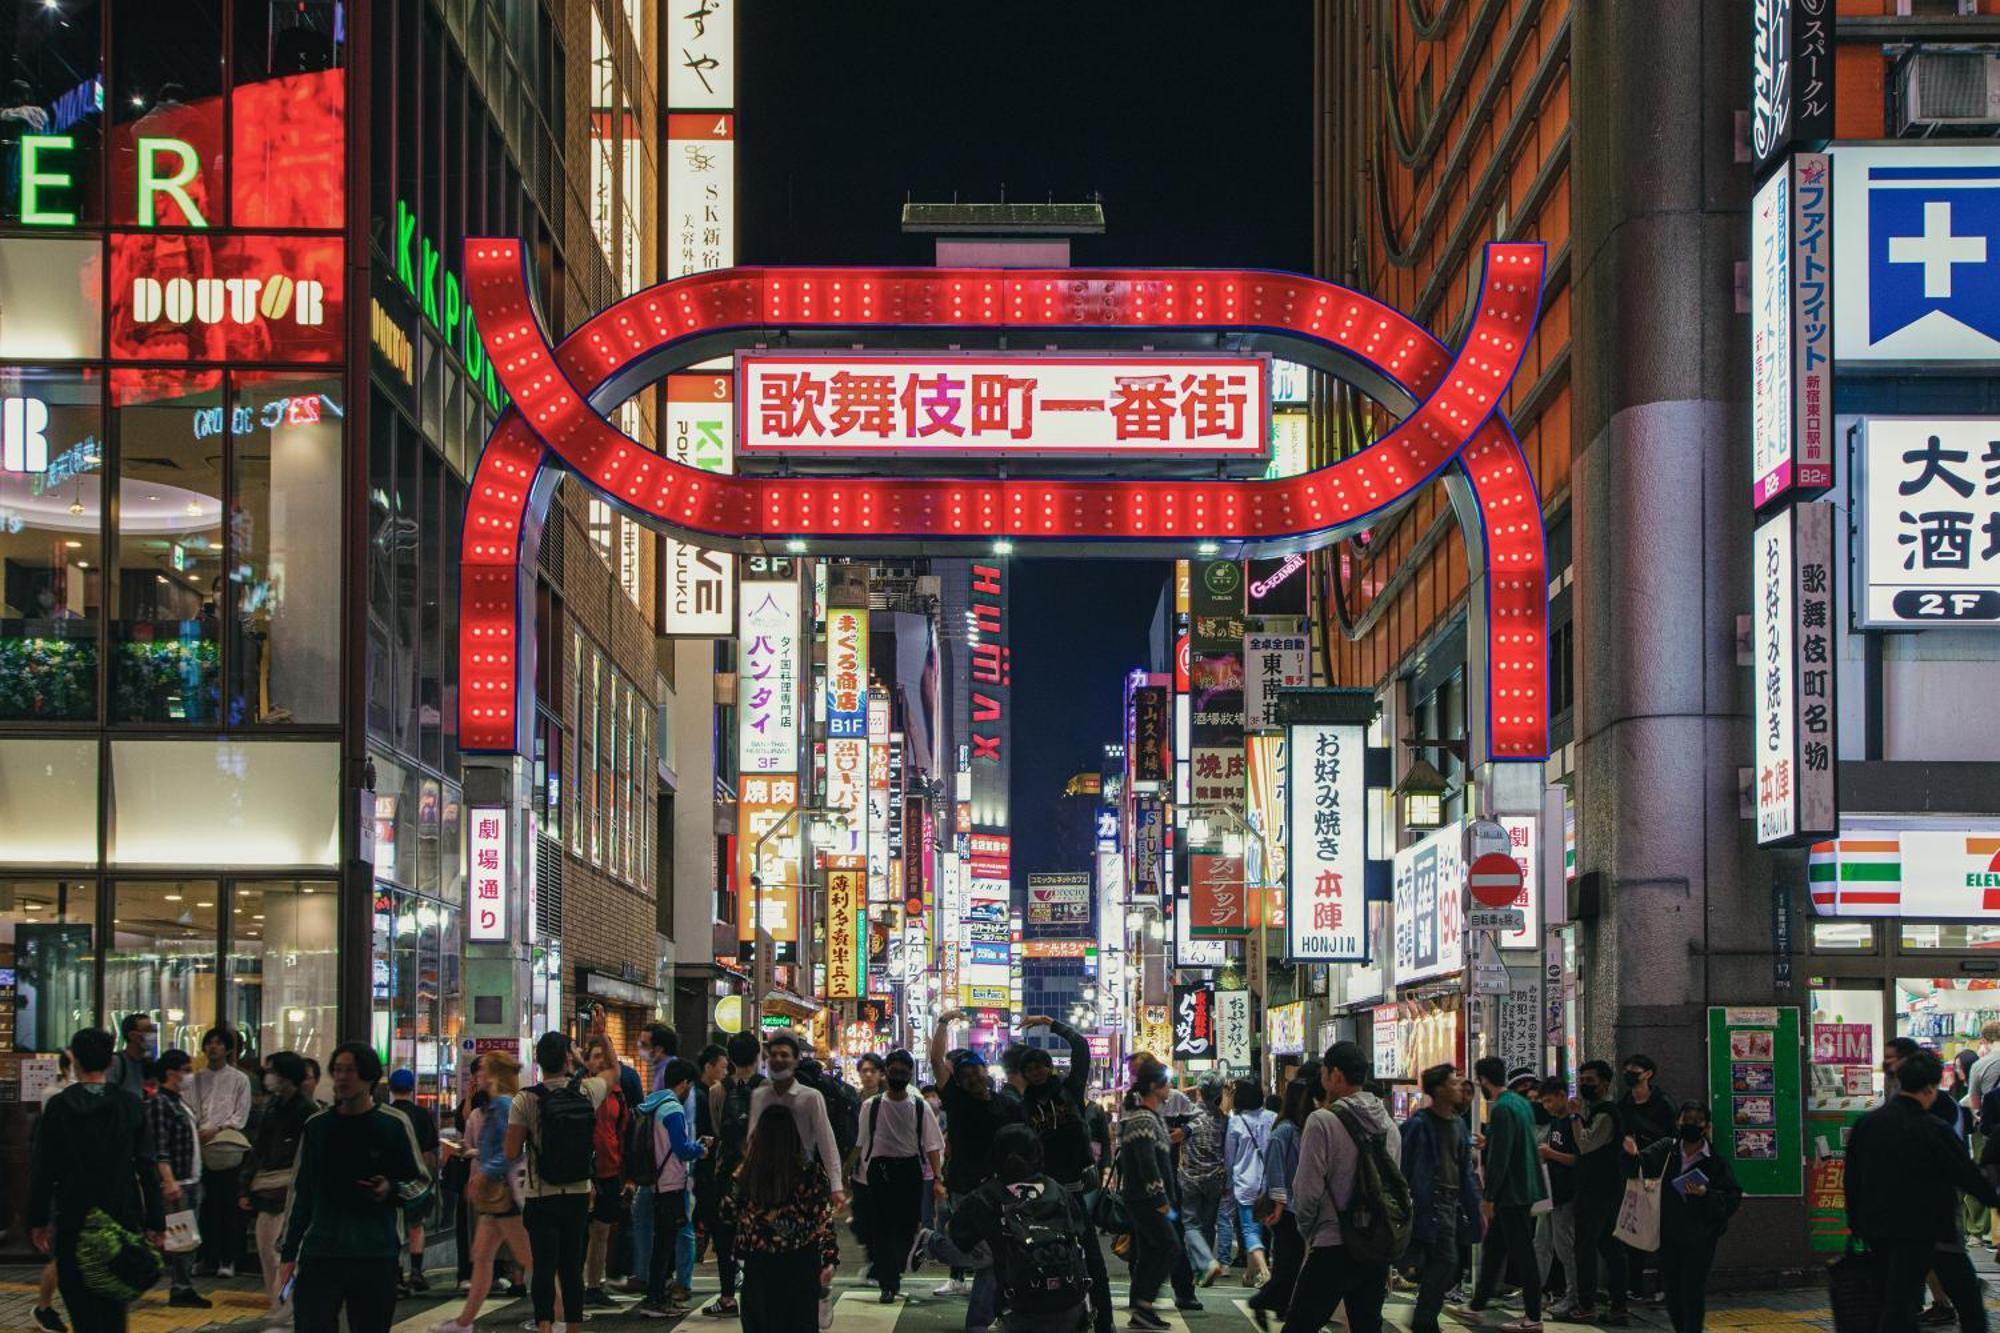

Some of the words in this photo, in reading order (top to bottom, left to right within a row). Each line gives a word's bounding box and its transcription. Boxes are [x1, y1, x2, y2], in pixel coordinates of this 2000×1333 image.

[1801, 20, 1828, 119] スパークル
[712, 117, 728, 136] 4
[133, 274, 324, 325] DOUTOR
[1800, 187, 1827, 371] ファイトフィット
[713, 378, 727, 399] 3
[760, 371, 1247, 441] 歌舞伎町一番街
[1806, 375, 1820, 459] 新宿東口駅前
[1800, 468, 1829, 483] B2F
[1899, 435, 2000, 499] 大
[1897, 510, 2000, 570] 酒
[1918, 594, 1981, 616] 2F
[747, 635, 776, 735] バンタイ
[780, 636, 792, 728] タイ国料理専門店
[1802, 563, 1829, 771] 歌舞伎町名物
[831, 718, 863, 733] B1F
[758, 756, 779, 768] 3F
[1314, 732, 1341, 861] お好み焼き
[478, 818, 499, 929] 劇場通り
[1314, 869, 1342, 931] 本陣
[1302, 936, 1356, 953] HONJIN
[1819, 1032, 1869, 1058] SIM
